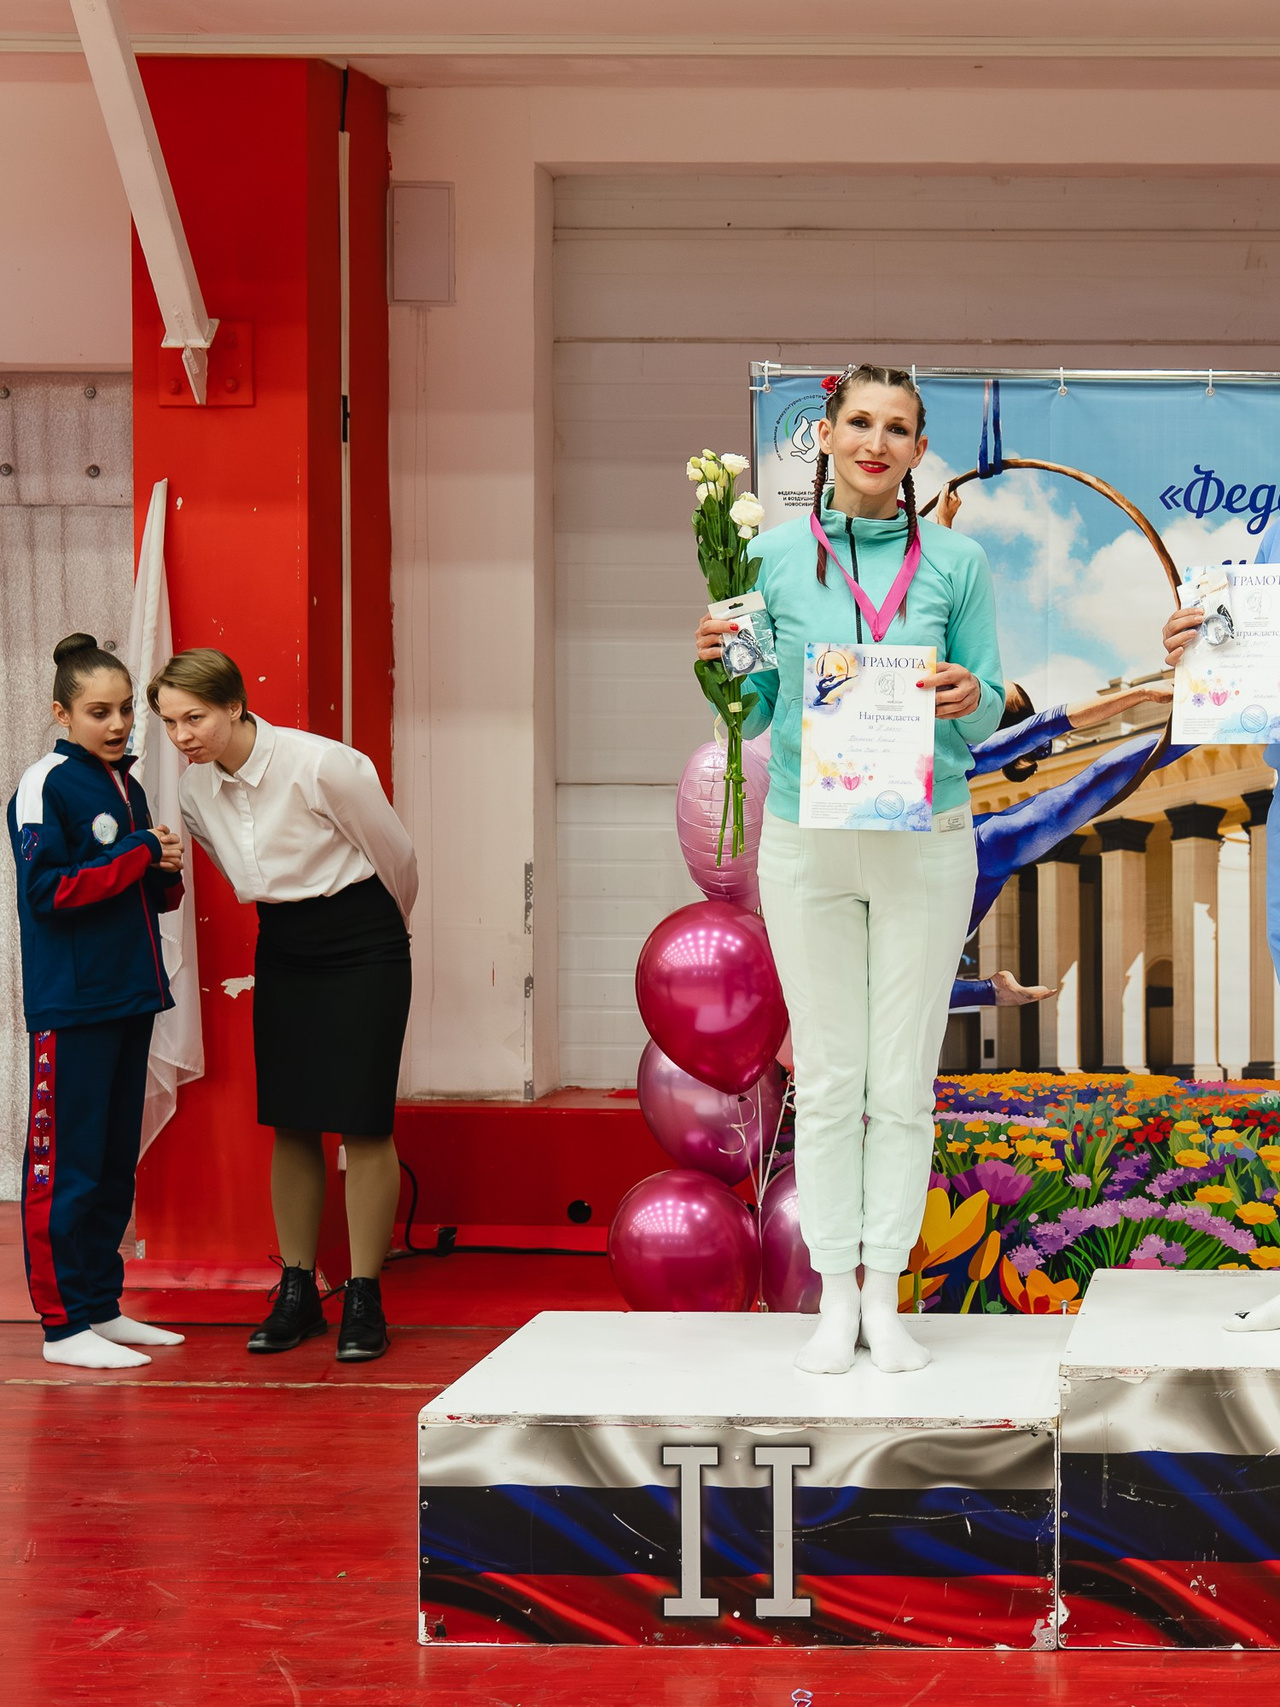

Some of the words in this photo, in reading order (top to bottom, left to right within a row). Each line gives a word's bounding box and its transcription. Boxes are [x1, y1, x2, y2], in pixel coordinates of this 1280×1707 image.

[862, 656, 926, 669] ГРАМОТА
[859, 711, 920, 723] Награждается
[661, 1445, 812, 1618] II
